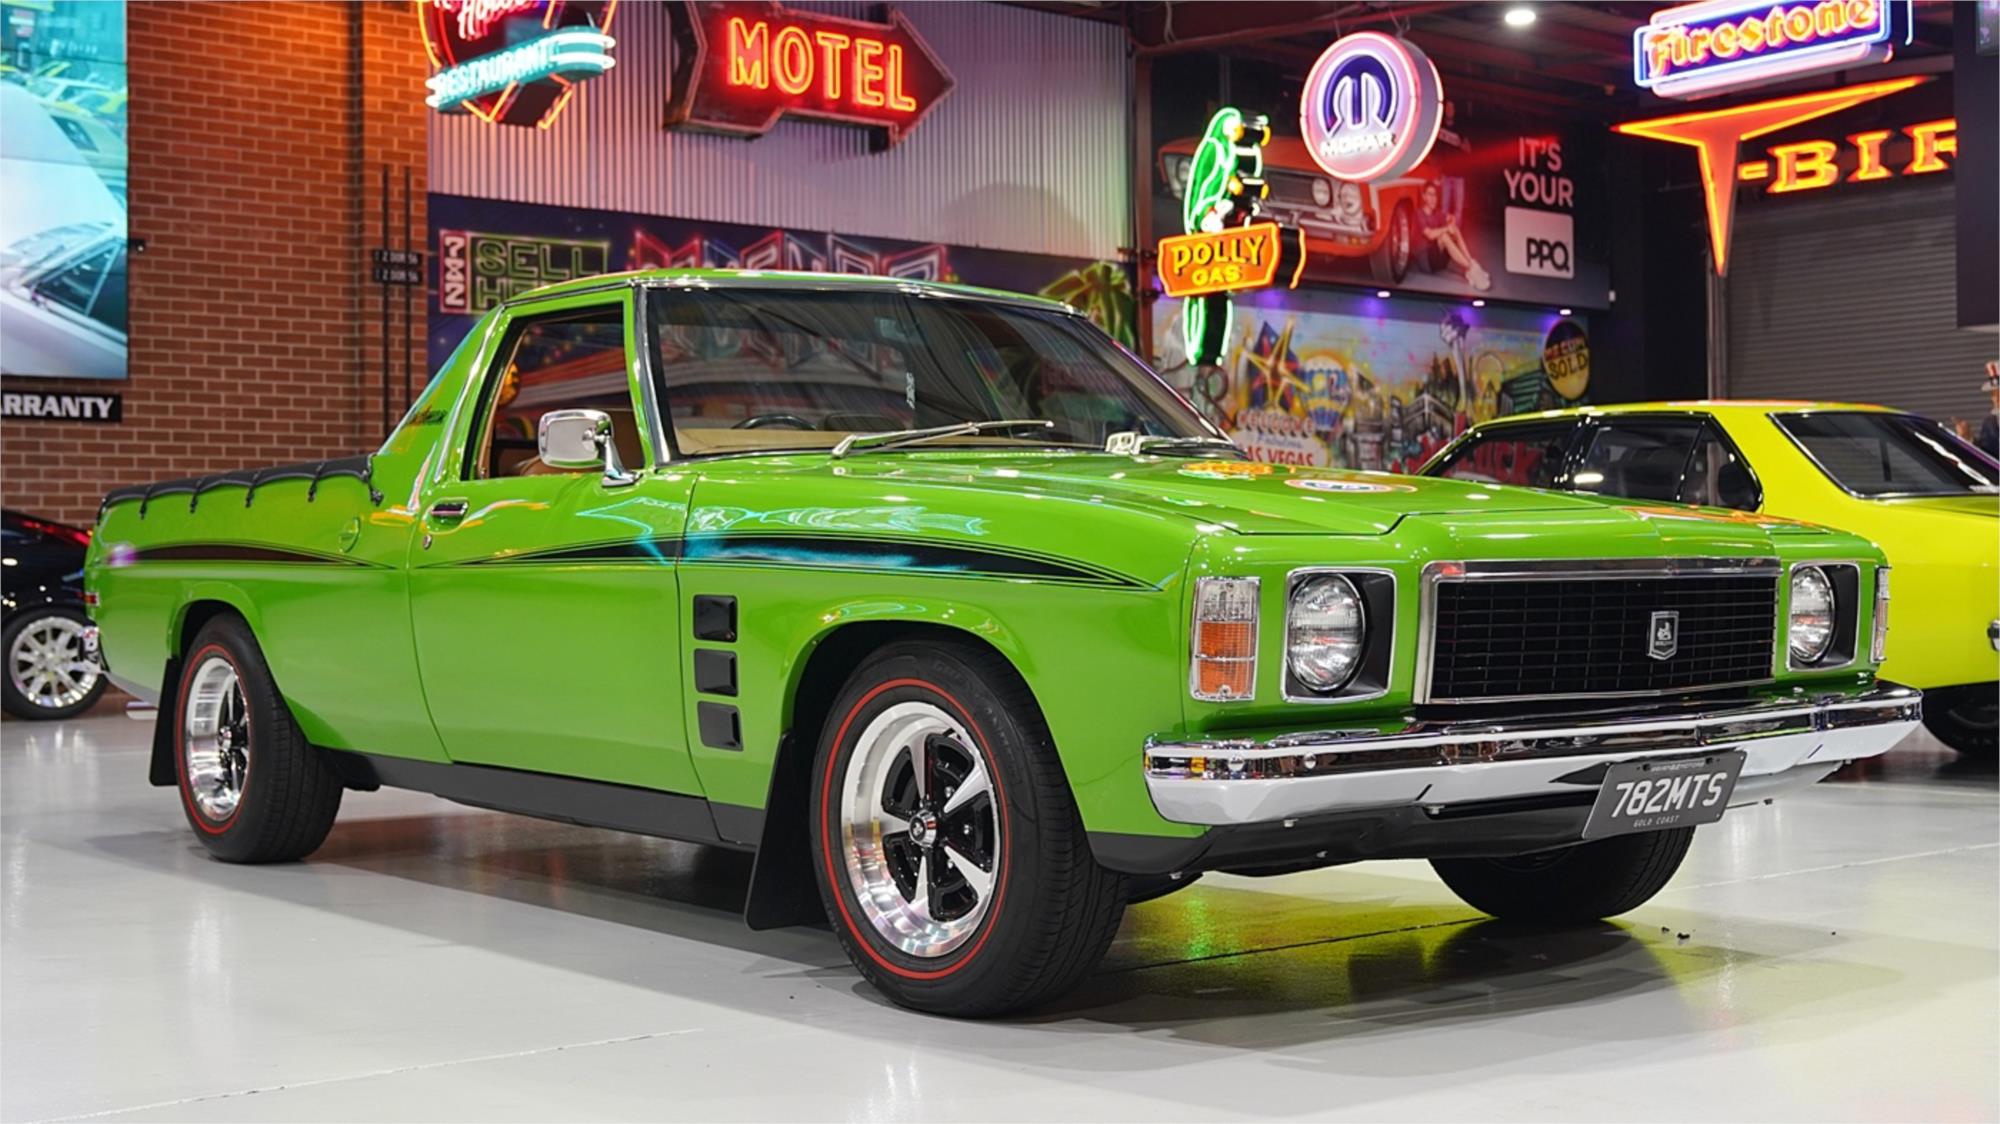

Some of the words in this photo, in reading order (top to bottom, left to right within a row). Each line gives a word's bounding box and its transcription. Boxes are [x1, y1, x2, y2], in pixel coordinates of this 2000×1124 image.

[1648, 0, 1878, 78] Firestone
[432, 37, 555, 99] RESTAURANT
[729, 17, 916, 112] MOTEL
[1320, 131, 1396, 157] MOPAR
[1519, 136, 1563, 172] IT'S
[1504, 168, 1574, 208] YOUR
[477, 240, 601, 280] SELL
[1171, 235, 1265, 275] POLLY
[1526, 237, 1570, 272] PPQ
[1191, 264, 1241, 287] GAS
[1549, 353, 1588, 381] SOLD
[0, 393, 114, 419] RRANTY
[1266, 449, 1314, 467] VEGAS
[1611, 773, 1727, 818] 782MTS
[1633, 818, 1652, 828] GOLD
[1656, 815, 1680, 827] COAST
